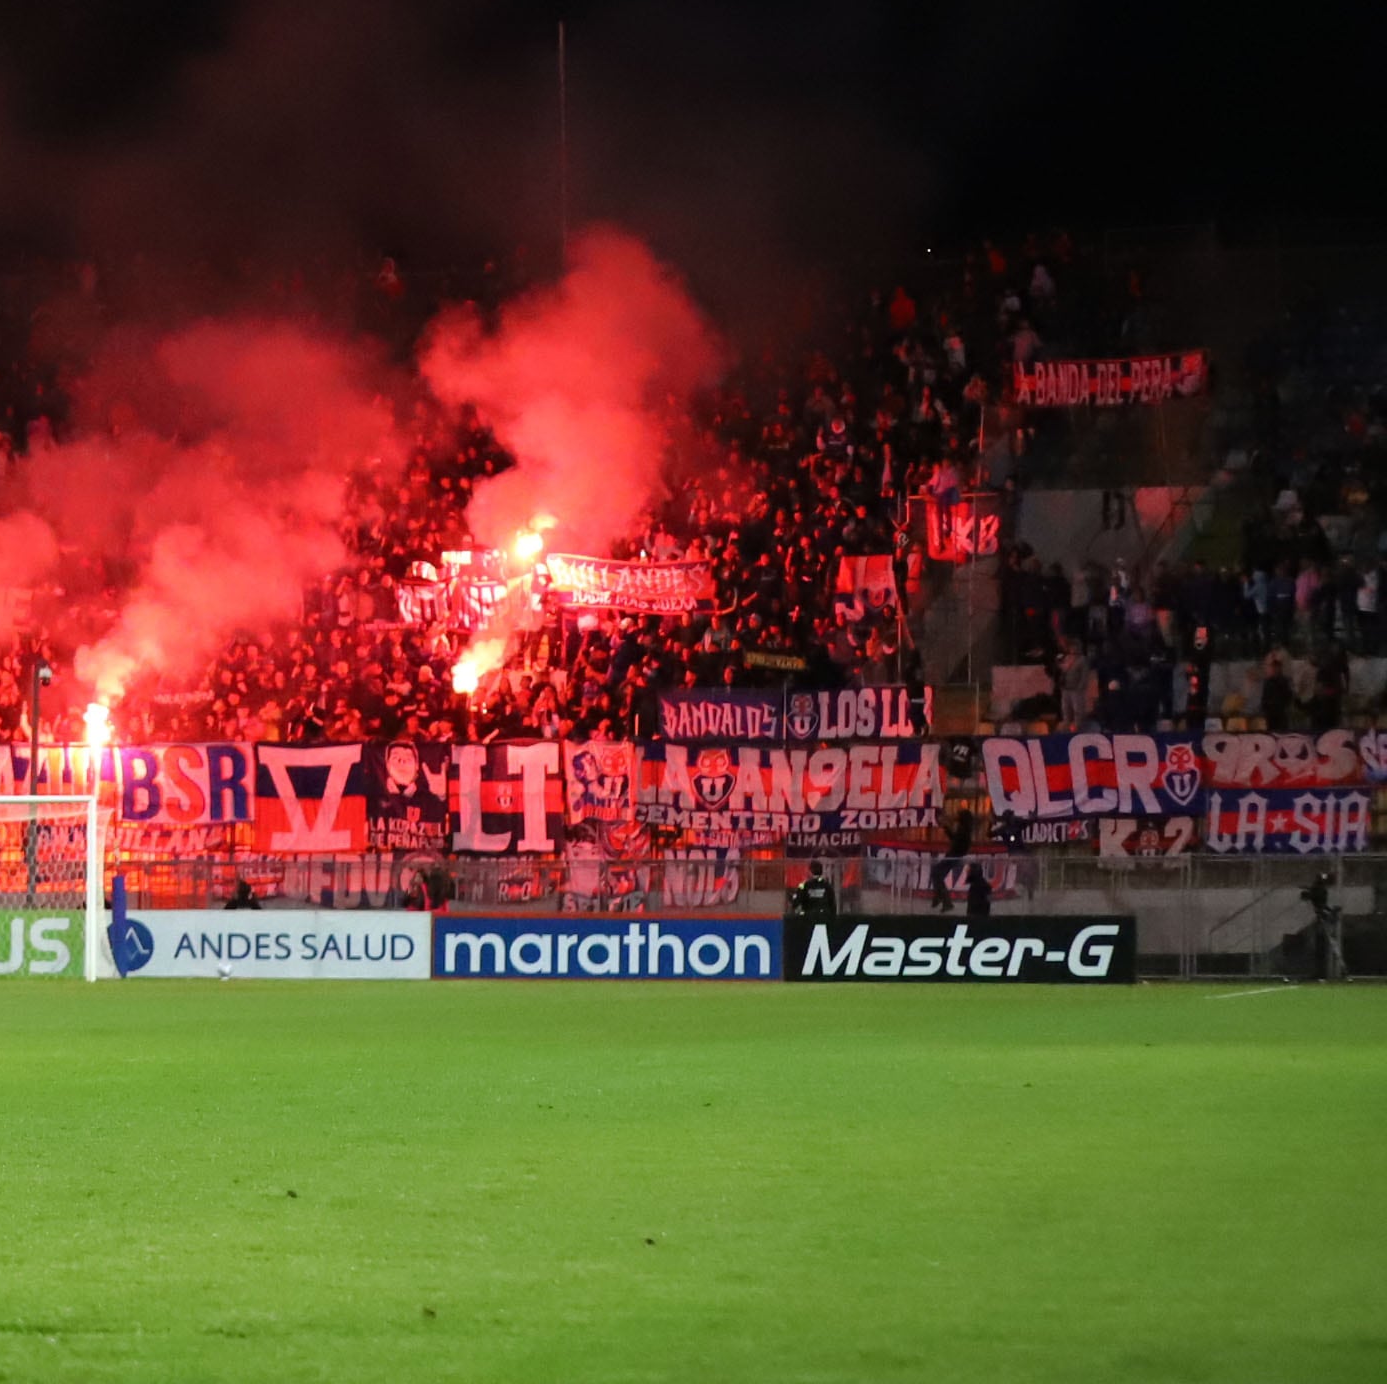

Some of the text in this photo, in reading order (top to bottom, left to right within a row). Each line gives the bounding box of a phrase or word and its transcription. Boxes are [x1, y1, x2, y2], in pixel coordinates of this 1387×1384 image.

[818, 689, 877, 738] LOS
[122, 744, 250, 822] BSR
[258, 744, 363, 851] V
[1206, 791, 1371, 854] LA SIA
[173, 933, 415, 961] ANDES SALUD
[444, 922, 772, 975] marathon
[801, 923, 1120, 977] Master-G
